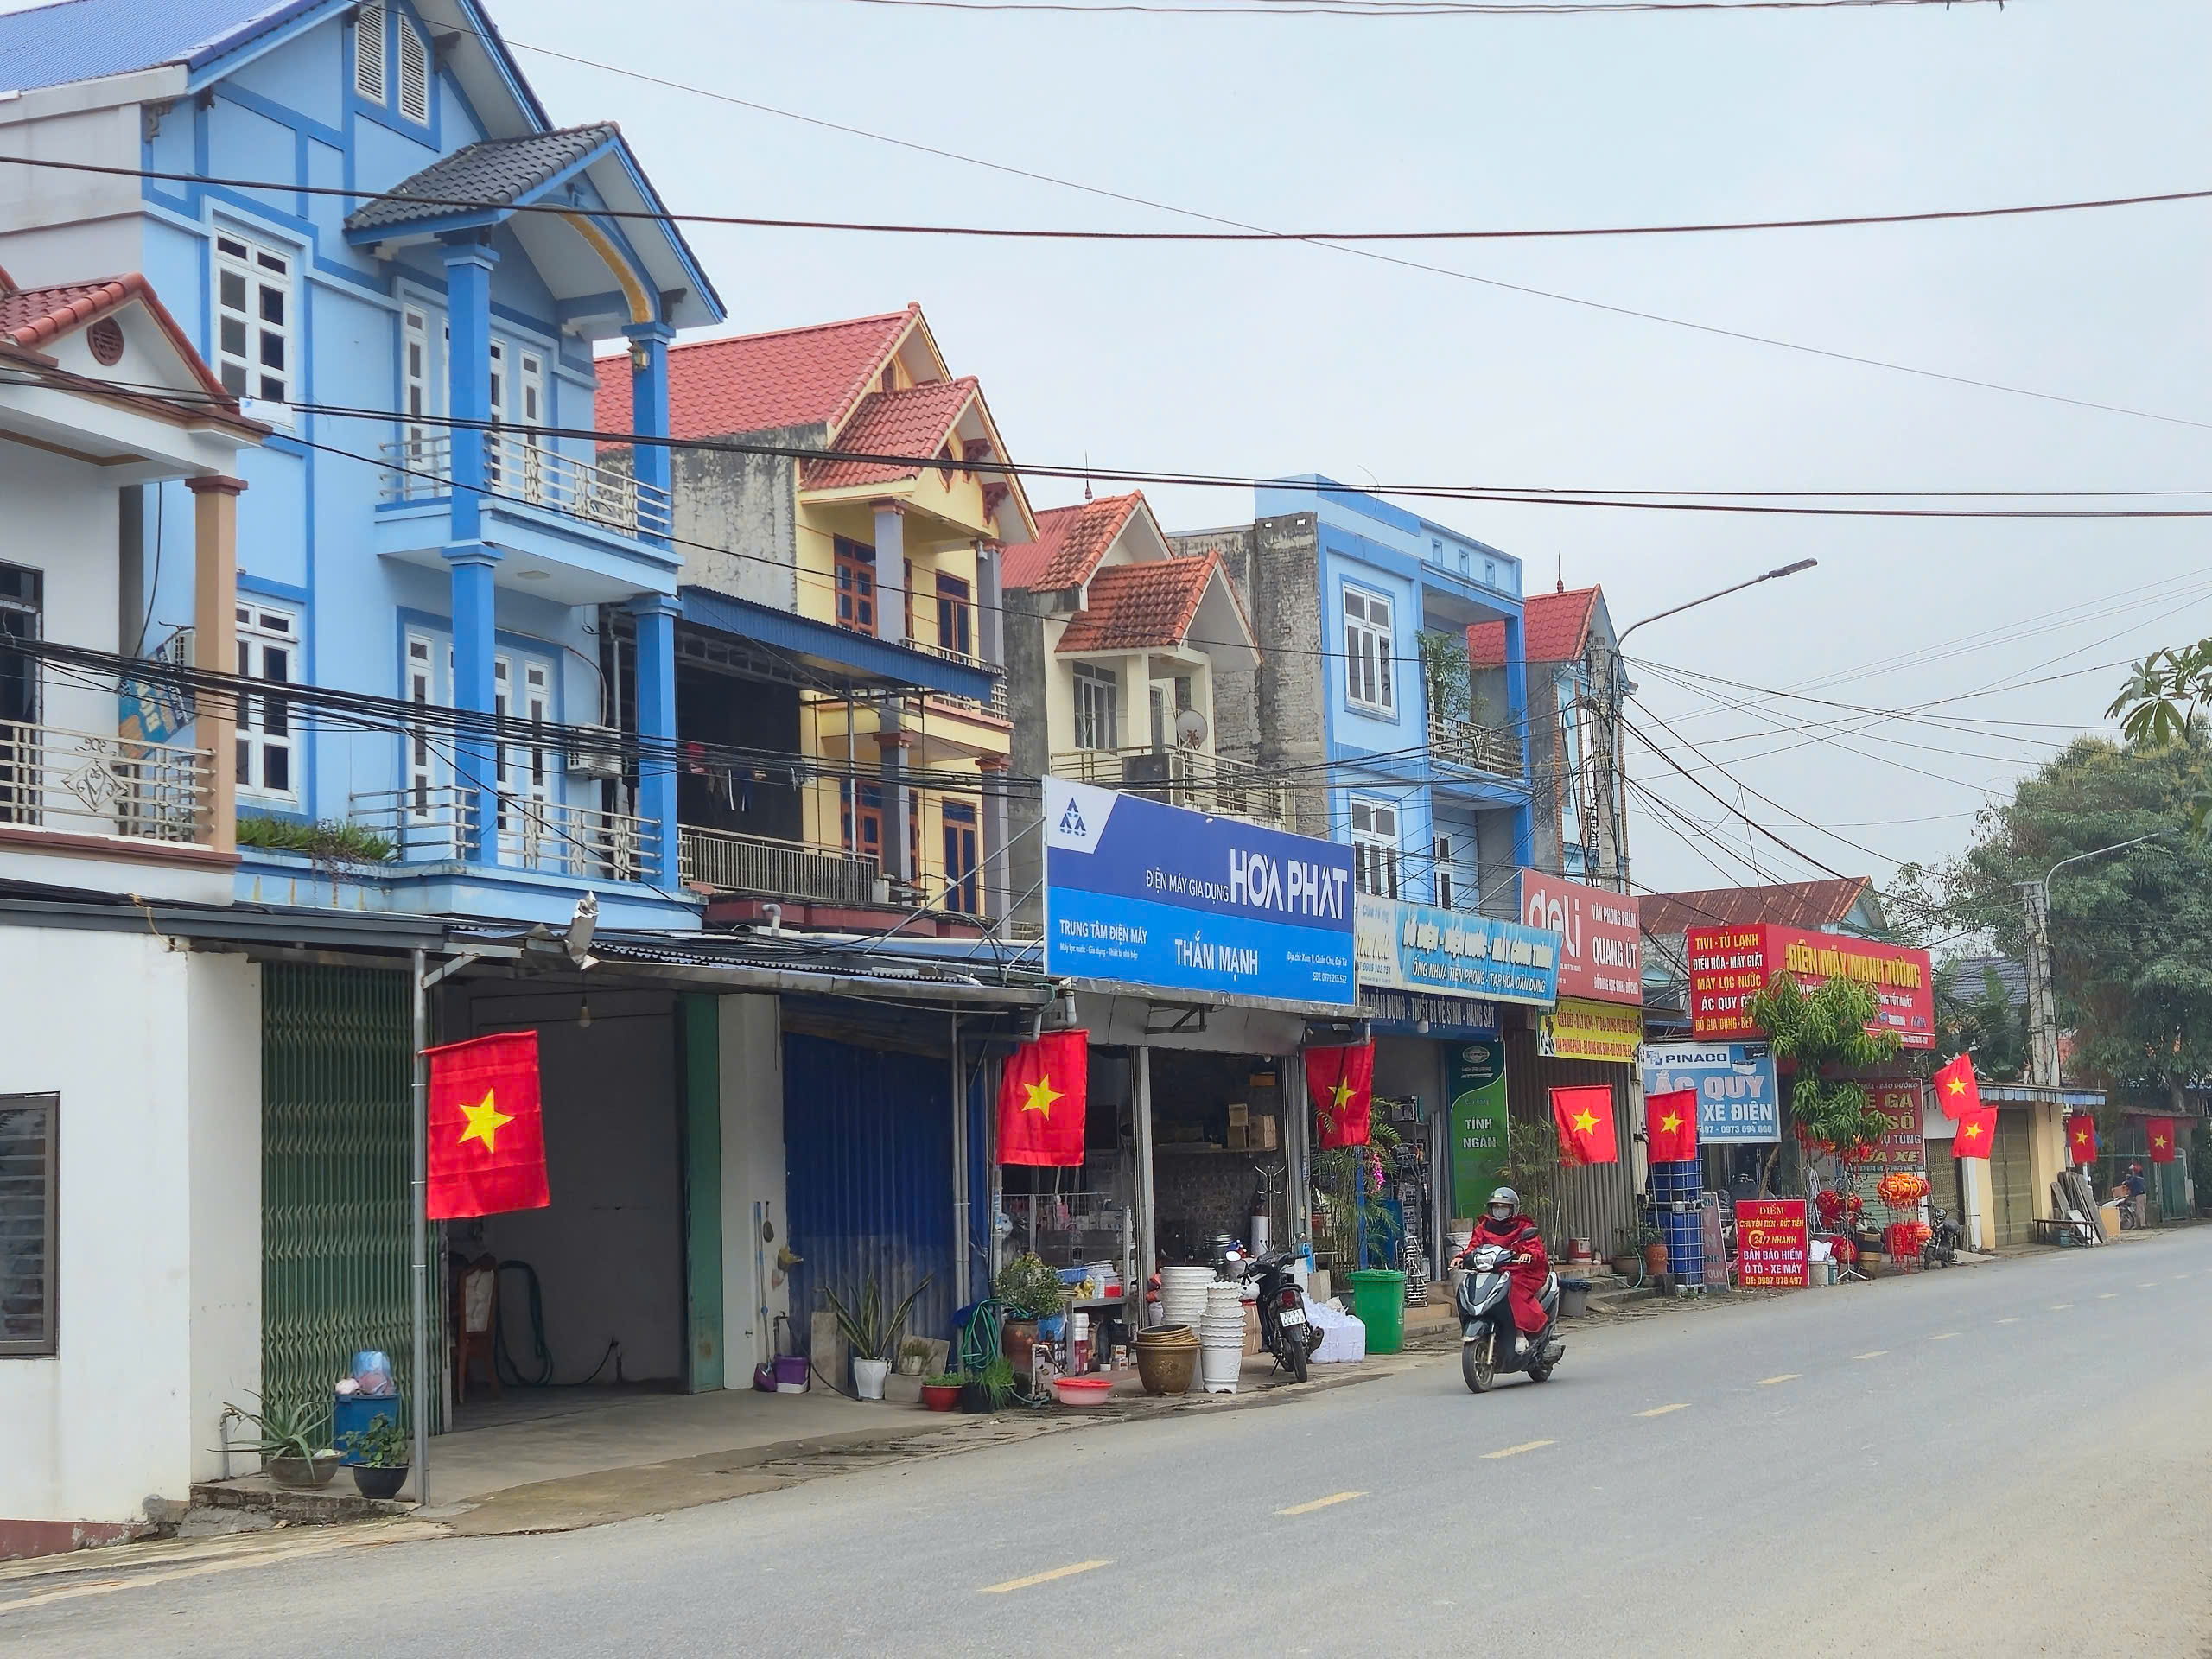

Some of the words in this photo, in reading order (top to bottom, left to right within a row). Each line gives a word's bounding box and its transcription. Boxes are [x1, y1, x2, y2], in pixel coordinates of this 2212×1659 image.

[1146, 867, 1166, 893] ĐIỆN
[1169, 873, 1187, 893] MÁY
[1188, 878, 1204, 897] GIA
[1205, 881, 1229, 904] DỤNG
[1287, 859, 1348, 920] PHÁT
[1059, 919, 1089, 938] TRUNG
[1090, 920, 1108, 939] TÂM
[1109, 924, 1128, 946] ĐIỆN
[1130, 926, 1147, 944] MÁY
[1695, 937, 1713, 950] TIVI
[1719, 931, 1731, 948] TỦ
[1733, 933, 1758, 950] LẠNH
[1175, 930, 1215, 970] THẮM
[1218, 945, 1258, 982] MẠNH
[1592, 936, 1624, 967] QUANG
[1625, 936, 1637, 969] ÚT
[1730, 952, 1745, 969] MÁY
[1747, 951, 1763, 969] GIẶT
[1785, 939, 1818, 979] ĐIỆN
[1412, 954, 1428, 976] ỐNG
[1428, 962, 1447, 983] NHỰA
[1465, 969, 1485, 986] PHONG
[1489, 972, 1503, 992] TẠP
[1515, 974, 1529, 991] DÂN
[1529, 978, 1546, 996] DỤNG
[1697, 975, 1716, 990] MÁY
[1719, 976, 1735, 991] LỌC
[1738, 971, 1762, 988] NƯỚC
[1387, 995, 1406, 1025] DỤNG
[1718, 996, 1738, 1012] QUY
[1707, 1018, 1718, 1031] GIA
[1719, 1017, 1738, 1033] DỤNG
[1665, 1053, 1727, 1063] PINACO
[1703, 1075, 1765, 1102] QUY
[1885, 1092, 1914, 1109] GA
[1703, 1104, 1726, 1122] XE
[1731, 1101, 1773, 1125] ĐIỆN
[1887, 1109, 1915, 1130] SỐ
[1465, 1116, 1492, 1130] TÍNH
[1721, 1125, 1739, 1134] 0973
[1893, 1132, 1922, 1145] TÙNG
[1893, 1150, 1920, 1162] XE
[1759, 1202, 1784, 1215] ĐIỂM
[1780, 1217, 1791, 1227] RÚT
[1754, 1236, 1770, 1244] 24/7
[1771, 1236, 1796, 1244] NHANH
[1743, 1249, 1761, 1260] BÁN
[1762, 1248, 1780, 1260] BẢO
[1781, 1247, 1802, 1260] HIỂM
[1745, 1262, 1751, 1274] Ô
[1752, 1262, 1763, 1274] TÔ
[1770, 1264, 1782, 1274] XE
[1783, 1262, 1802, 1274] MÁY
[1789, 1276, 1802, 1285] 497
